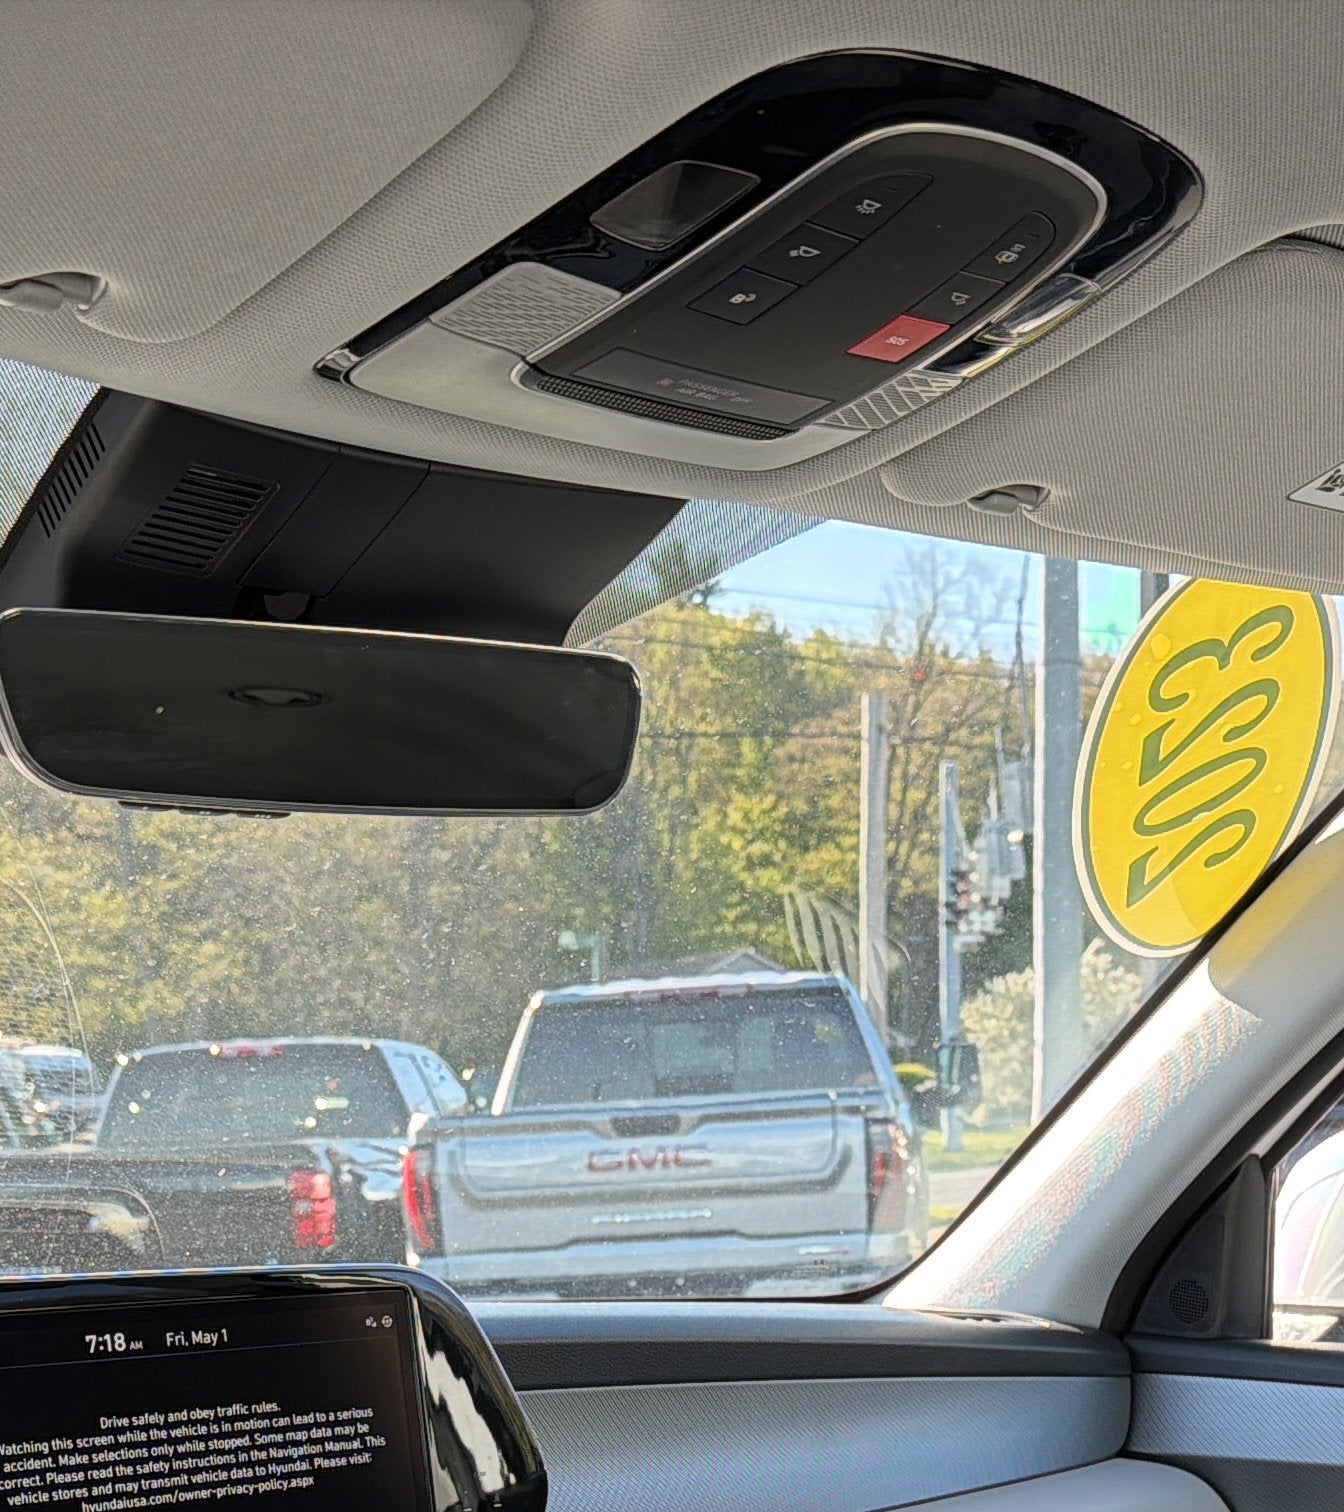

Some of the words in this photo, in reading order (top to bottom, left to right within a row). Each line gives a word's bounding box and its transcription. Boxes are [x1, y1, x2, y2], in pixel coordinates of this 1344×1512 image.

[885, 336, 909, 346] SOS
[586, 1142, 712, 1173] GMC
[85, 1332, 127, 1353] 7:18
[130, 1340, 143, 1351] AM
[165, 1331, 189, 1347] Fri,
[191, 1330, 218, 1348] May
[221, 1328, 228, 1343] 1
[51, 1437, 74, 1451] this
[76, 1434, 115, 1448] screen
[117, 1429, 148, 1444] while
[149, 1427, 168, 1440] the
[169, 1423, 208, 1438] vehicle
[209, 1422, 219, 1435] is
[221, 1420, 232, 1433] in
[233, 1417, 270, 1432] motion
[272, 1416, 291, 1428] can
[292, 1411, 315, 1425] lead
[316, 1411, 327, 1423] to
[328, 1411, 335, 1421] a
[336, 1406, 374, 1420] serious
[99, 1415, 129, 1429] Drive
[131, 1411, 165, 1426] safely
[167, 1409, 188, 1422] and
[190, 1408, 215, 1421] obey
[216, 1403, 249, 1418] traffic
[251, 1401, 281, 1414] rules.
[3, 1459, 56, 1473] accident.
[58, 1451, 89, 1467] Make
[91, 1446, 149, 1463] selections
[150, 1443, 174, 1457] only
[176, 1439, 206, 1454] while
[208, 1436, 253, 1452] stopped.
[254, 1432, 284, 1445] Some
[285, 1430, 308, 1443] map
[310, 1425, 332, 1439] data
[334, 1424, 356, 1437] may
[357, 1421, 370, 1434] be
[46, 1469, 85, 1485] Please
[87, 1465, 113, 1480] read
[115, 1462, 134, 1477] the
[136, 1460, 170, 1475] safety
[172, 1451, 236, 1470] instructions
[238, 1450, 248, 1463] in
[250, 1448, 268, 1461] the
[269, 1443, 323, 1459] Navigation
[324, 1438, 364, 1453] Manual.
[365, 1434, 387, 1448] This
[7, 1491, 50, 1507] vehicle
[52, 1486, 89, 1501] stores
[91, 1482, 113, 1497] and
[115, 1480, 139, 1495] may
[141, 1474, 189, 1491] transmit
[190, 1469, 228, 1484] vehicle
[230, 1465, 253, 1479] data
[255, 1464, 267, 1477] to
[268, 1459, 313, 1477] Hyundai.
[314, 1454, 348, 1469] Please
